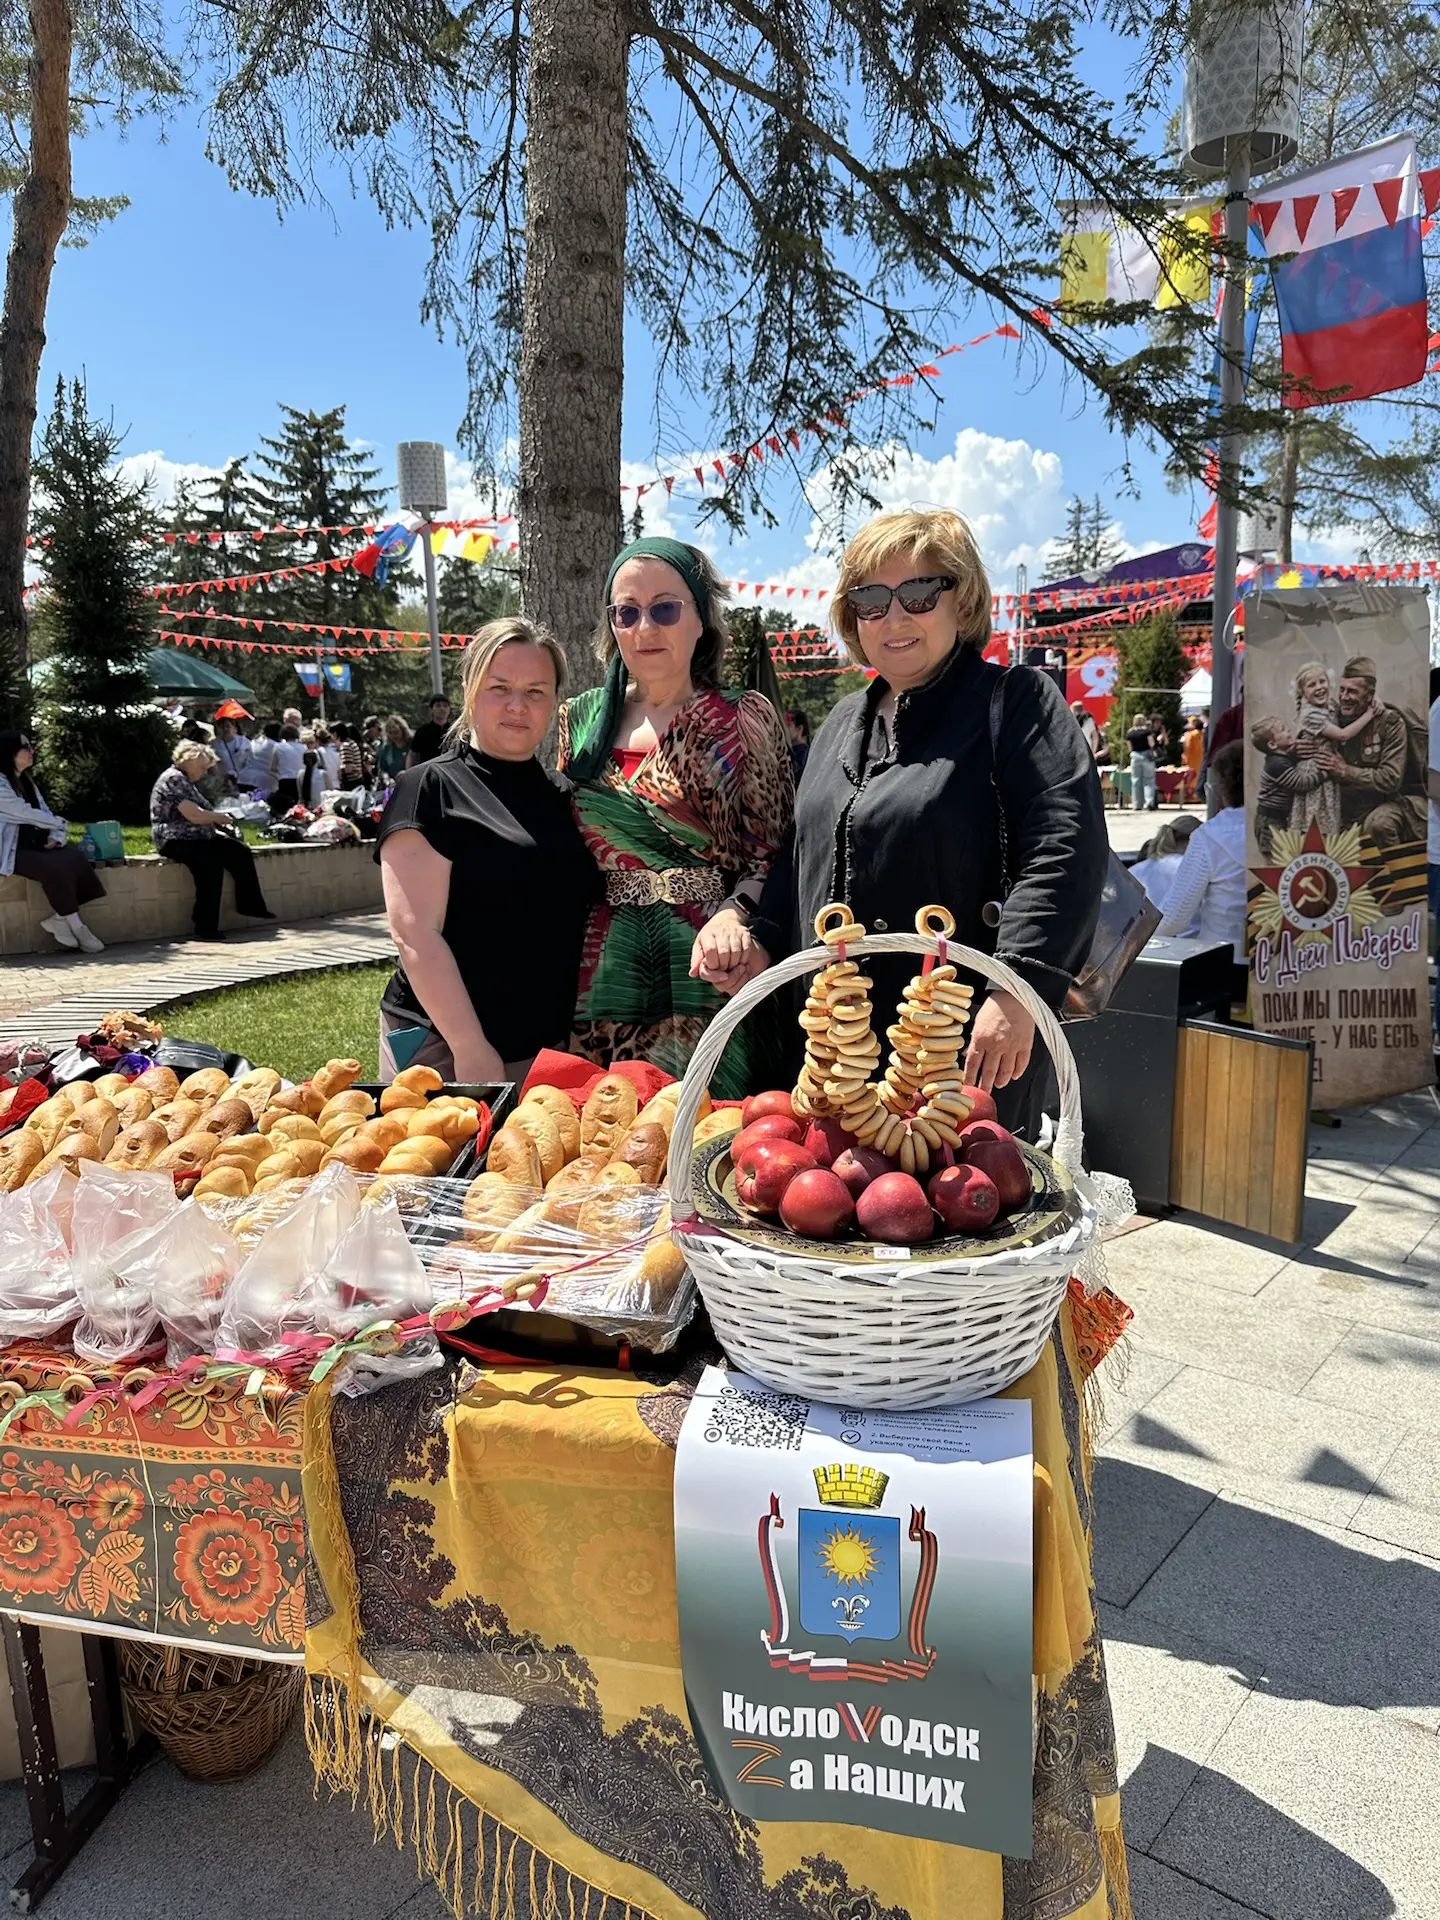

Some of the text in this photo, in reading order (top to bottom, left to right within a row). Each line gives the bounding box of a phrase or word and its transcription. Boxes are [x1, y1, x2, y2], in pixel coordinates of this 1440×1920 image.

[1281, 857, 1342, 924] ОТЕЧЕСТВЕННАЯ
[1256, 911, 1420, 987] С Днём Победы!
[1263, 988, 1417, 1023] ПОКА МЫ ПОМНИМ
[1333, 1025, 1343, 1049] У
[1350, 1025, 1377, 1048] НАС
[1384, 1024, 1418, 1048] ЕСТЬ
[873, 1422, 922, 1430] мобильного
[879, 1433, 920, 1442] Выберите
[921, 1421, 978, 1430] фотоаппарата
[869, 1439, 973, 1454] укажите сумму помощи.
[824, 1754, 966, 1813] Наших
